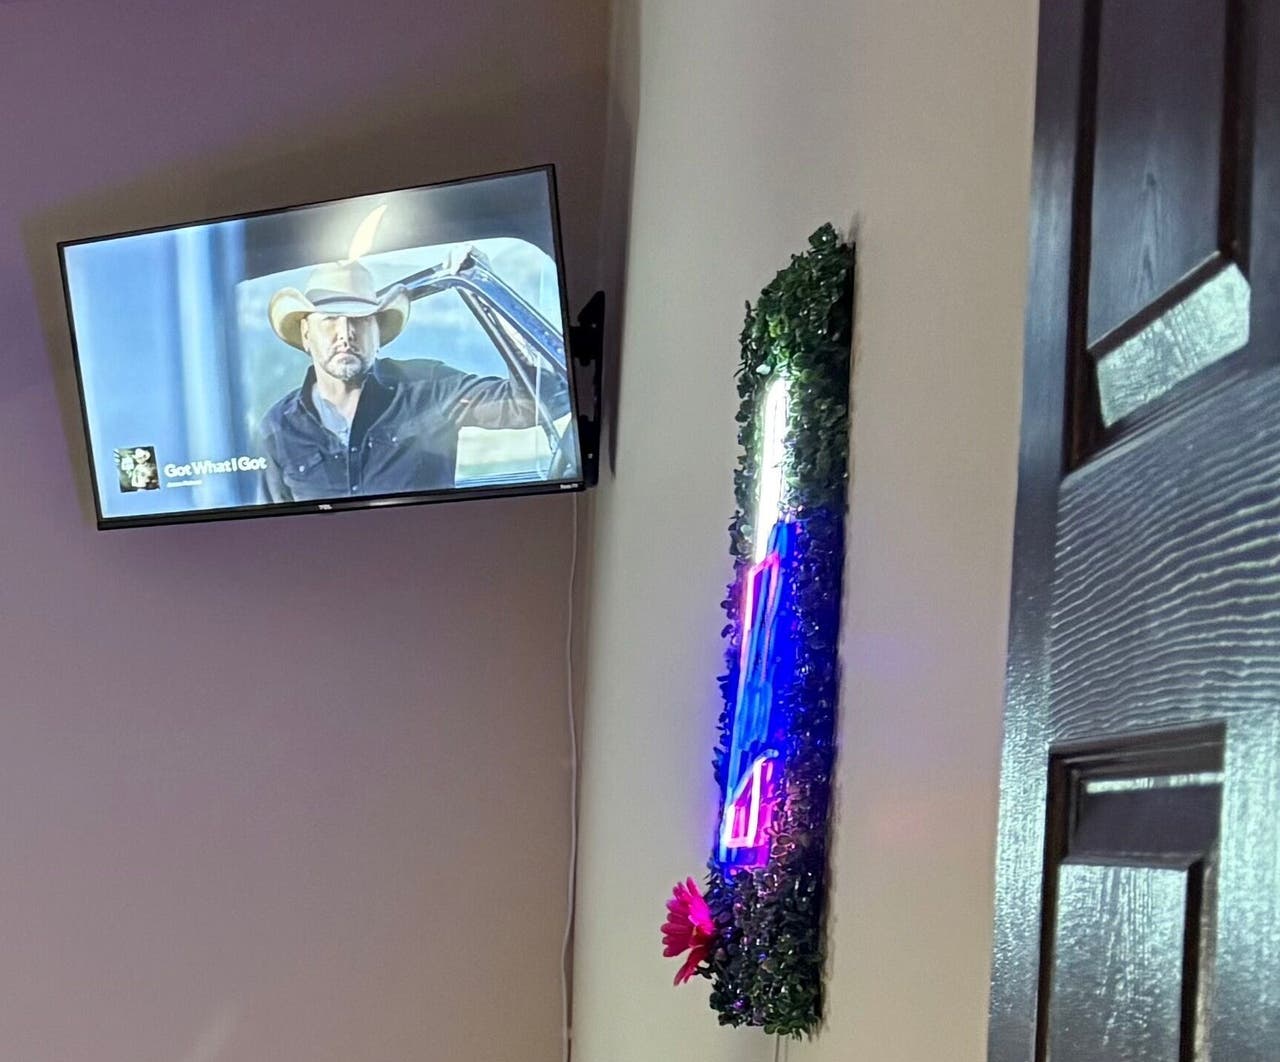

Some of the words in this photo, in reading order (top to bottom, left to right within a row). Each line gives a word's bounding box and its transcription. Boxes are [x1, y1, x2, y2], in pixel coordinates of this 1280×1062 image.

[164, 463, 192, 478] Got
[191, 460, 232, 475] What
[231, 457, 238, 472] I
[238, 456, 268, 471] Got
